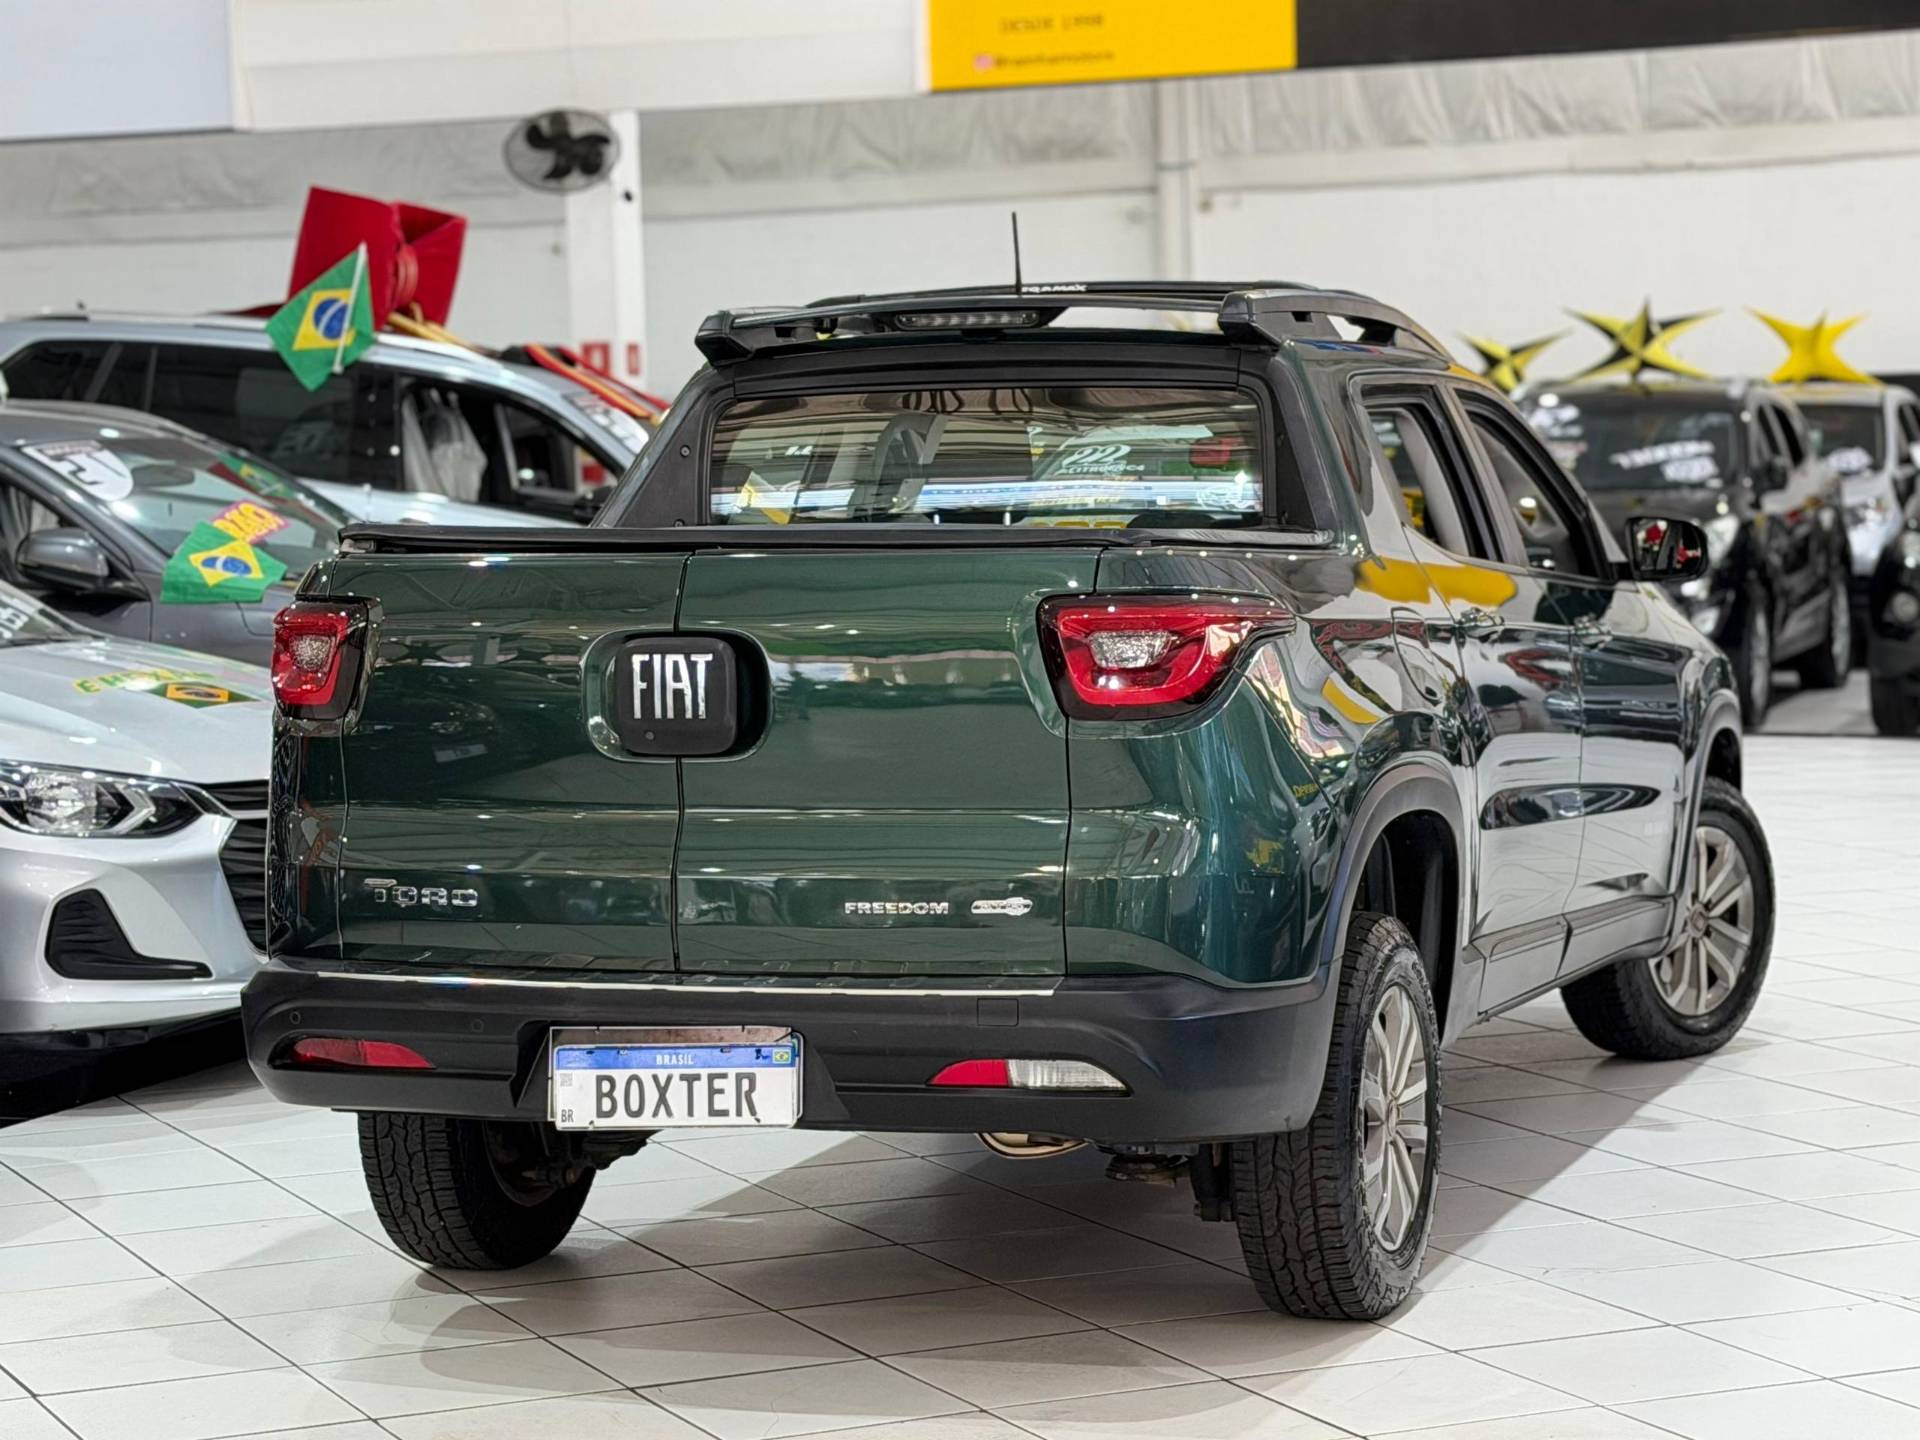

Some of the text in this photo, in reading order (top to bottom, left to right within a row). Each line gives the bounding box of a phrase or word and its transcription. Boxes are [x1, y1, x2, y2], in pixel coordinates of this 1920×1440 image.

[631, 653, 713, 719] FIAT
[844, 902, 950, 915] FREEDOM
[656, 1054, 694, 1066] BRASIL
[595, 1071, 759, 1119] BOXTER
[560, 1108, 575, 1123] BR
